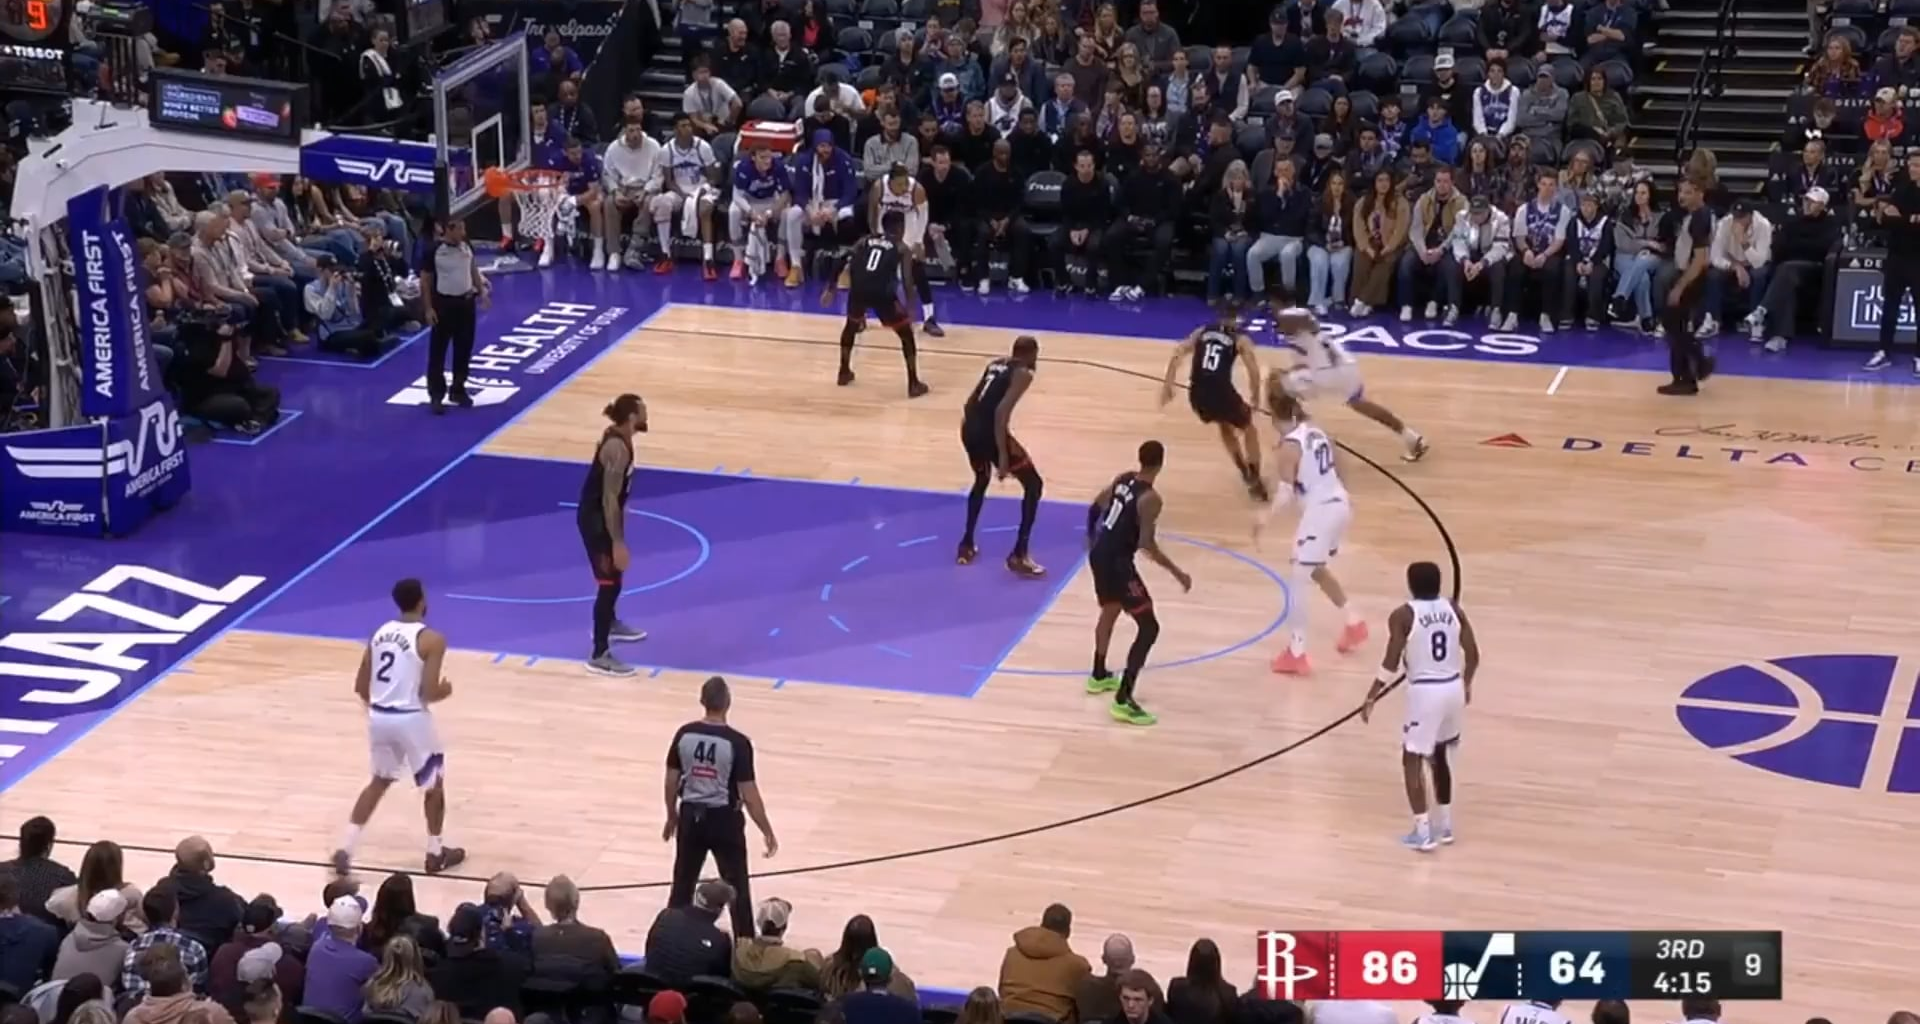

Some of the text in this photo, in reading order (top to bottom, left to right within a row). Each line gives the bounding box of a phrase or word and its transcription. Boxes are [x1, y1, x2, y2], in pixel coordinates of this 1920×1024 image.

[27, 0, 47, 30] 9
[13, 45, 64, 60] TISSOT
[866, 248, 882, 271] 0
[82, 229, 113, 398] AMERICA FIRST
[111, 230, 150, 391] AMERICA FIRST
[468, 302, 597, 371] HEALTH
[1202, 343, 1223, 371] 15
[1561, 437, 1809, 467] DELTA
[19, 510, 96, 523] AMERICA FIRST
[0, 564, 267, 705] JAZZ
[1431, 630, 1447, 662] 8
[376, 650, 396, 683] 2
[693, 740, 717, 766] 44
